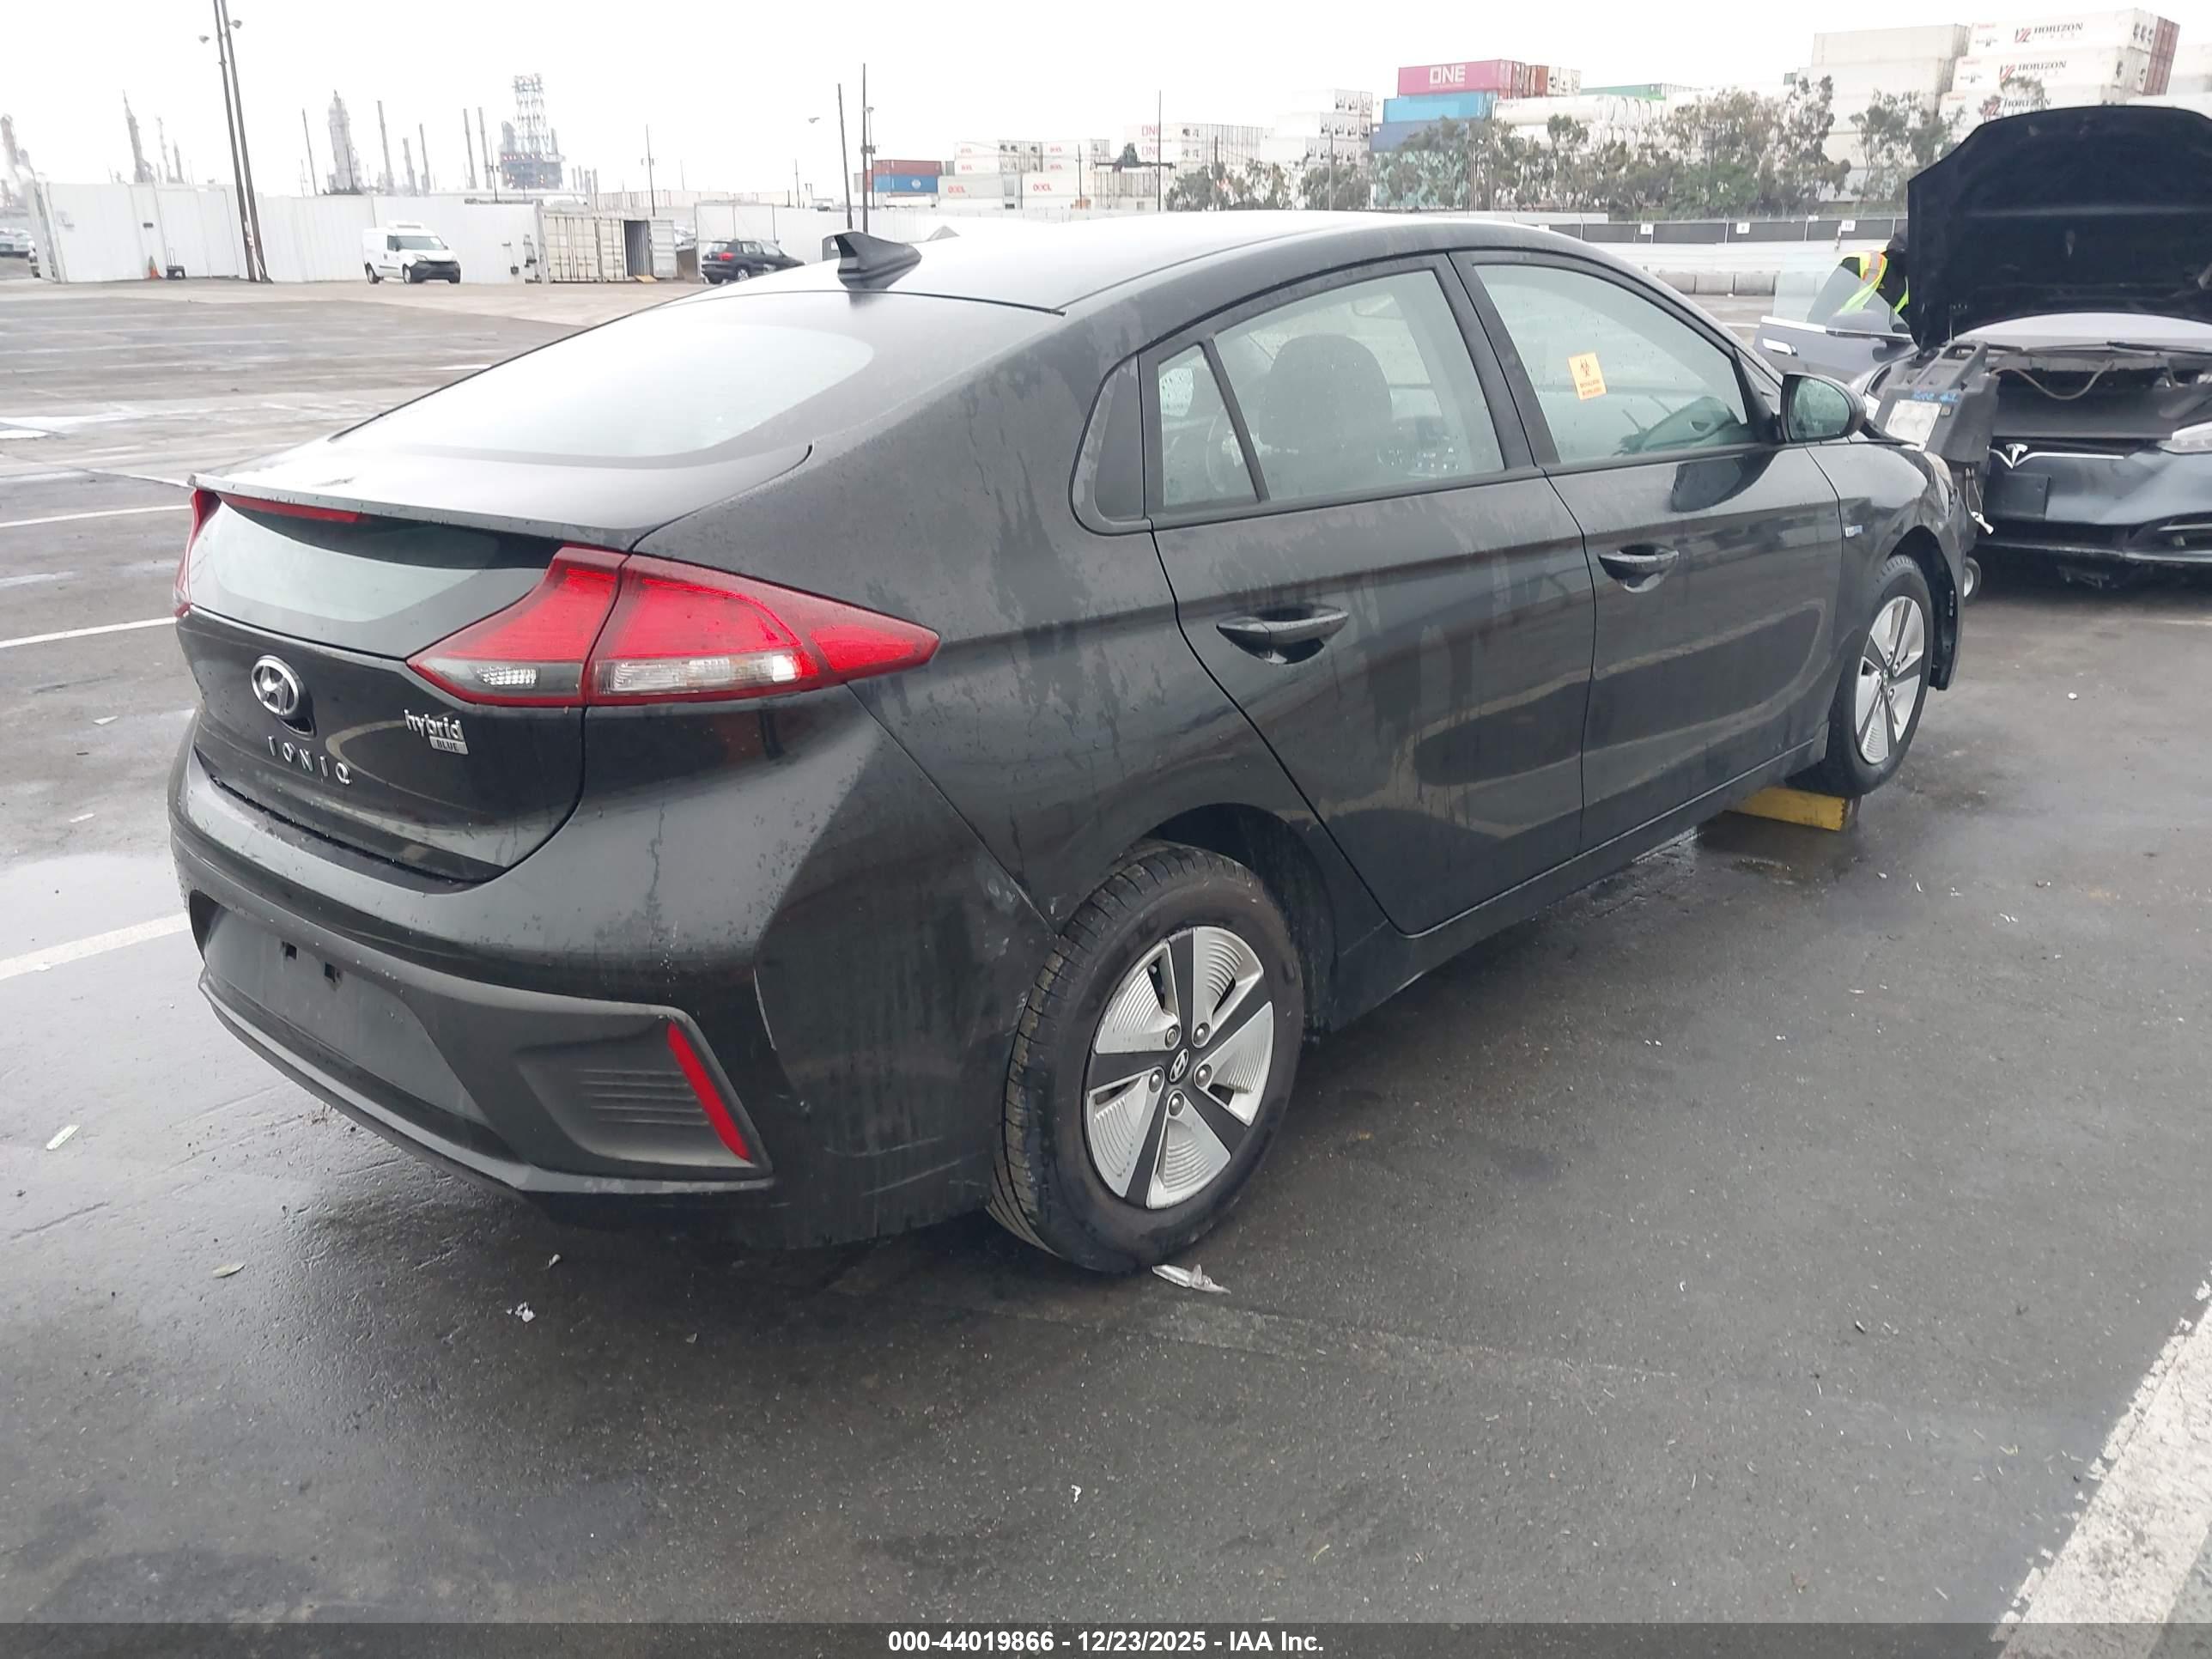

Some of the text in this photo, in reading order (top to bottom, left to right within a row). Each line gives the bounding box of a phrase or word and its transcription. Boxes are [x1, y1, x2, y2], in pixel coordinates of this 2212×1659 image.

[2033, 21, 2083, 34] HORIZON
[2018, 60, 2067, 71] HORIZON
[1429, 64, 1466, 84] ONE
[404, 708, 465, 742] hybrid
[436, 739, 459, 751] BLUE
[268, 735, 352, 785] IONIQ
